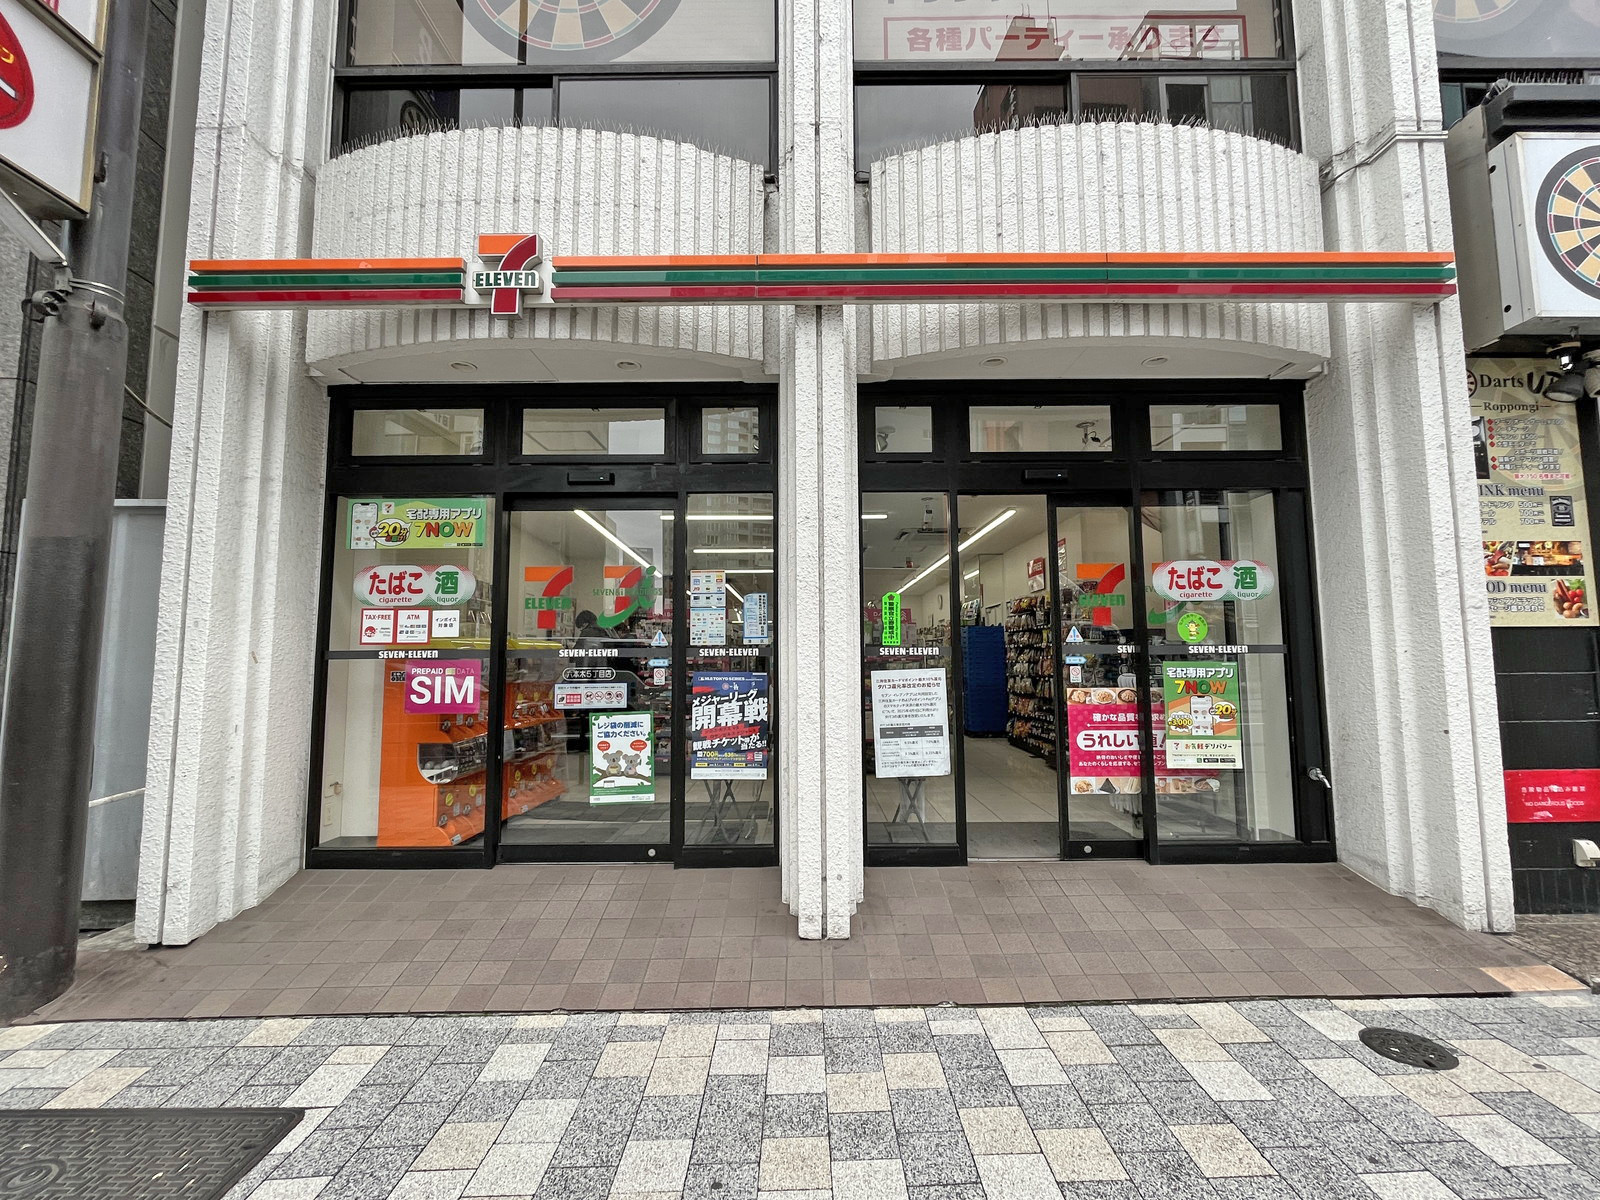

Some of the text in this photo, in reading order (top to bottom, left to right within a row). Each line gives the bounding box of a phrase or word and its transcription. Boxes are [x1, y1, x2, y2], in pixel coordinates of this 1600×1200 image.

[906, 25, 1225, 53] 各種パーティー承ります
[1480, 374, 1524, 388] Darts
[1483, 402, 1539, 412] Roppongi
[1508, 486, 1544, 496] menu
[407, 508, 482, 520] 宅配専用アプリ
[414, 522, 473, 538] 7NOW
[369, 571, 459, 595] たばこ 酒
[1168, 566, 1258, 590] たばこ 酒
[1510, 583, 1547, 593] menu
[379, 596, 459, 604] cigarette liquor
[1166, 667, 1234, 678] 宅配専用アプリ
[410, 676, 475, 704] SIM
[1174, 680, 1227, 694] 7NOW
[692, 688, 758, 706] メジャーリーグ
[692, 697, 768, 731] 開幕戦
[597, 721, 644, 729] レジ袋の削減に
[597, 730, 646, 738] ご協力ください。
[1185, 742, 1233, 750] お気軽デリバリー
